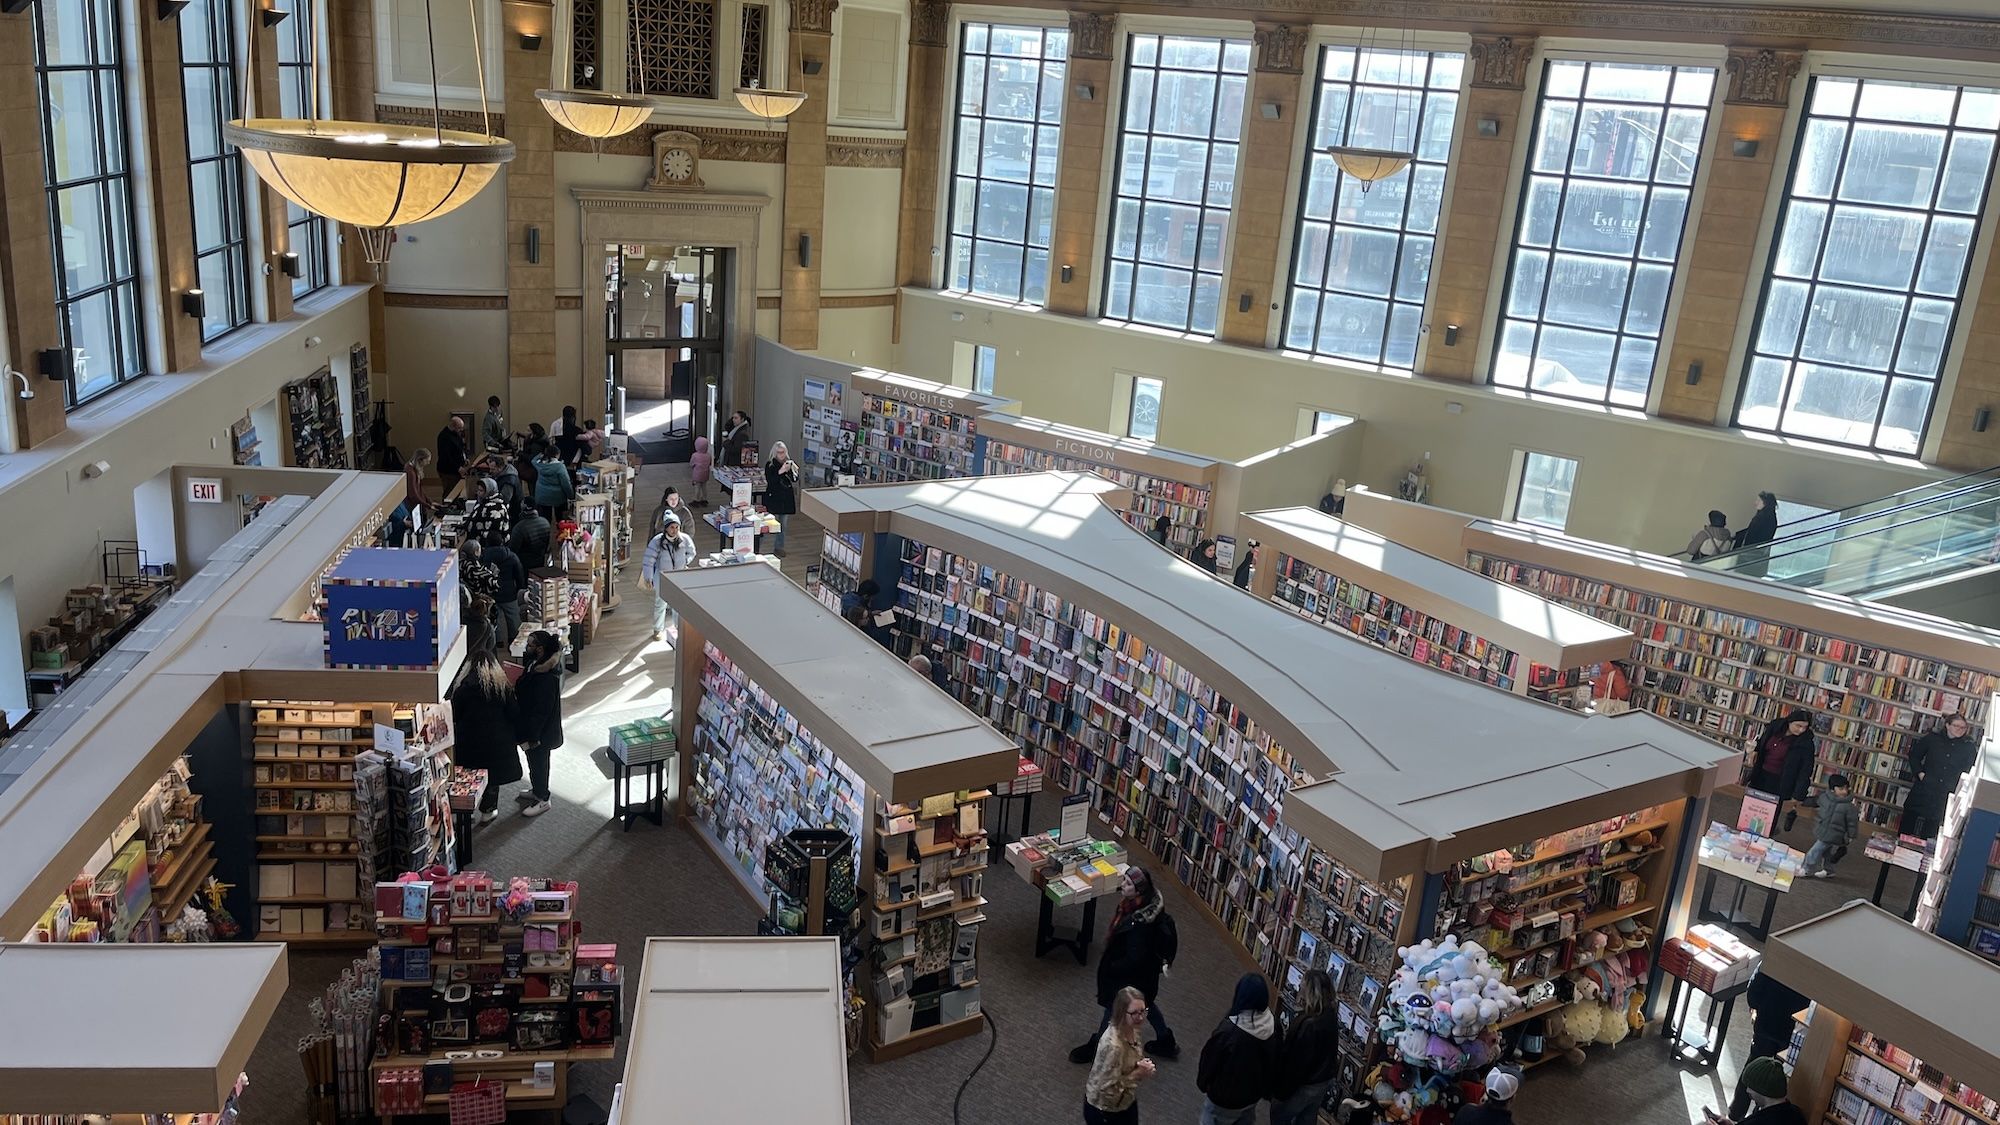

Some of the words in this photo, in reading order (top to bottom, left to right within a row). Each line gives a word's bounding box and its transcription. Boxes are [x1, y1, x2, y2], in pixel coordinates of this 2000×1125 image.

[630, 245, 642, 254] EXIT
[885, 385, 954, 409] FAVORITES
[1056, 439, 1115, 462] FICTION
[193, 484, 216, 499] EXIT
[352, 507, 383, 548] READERS
